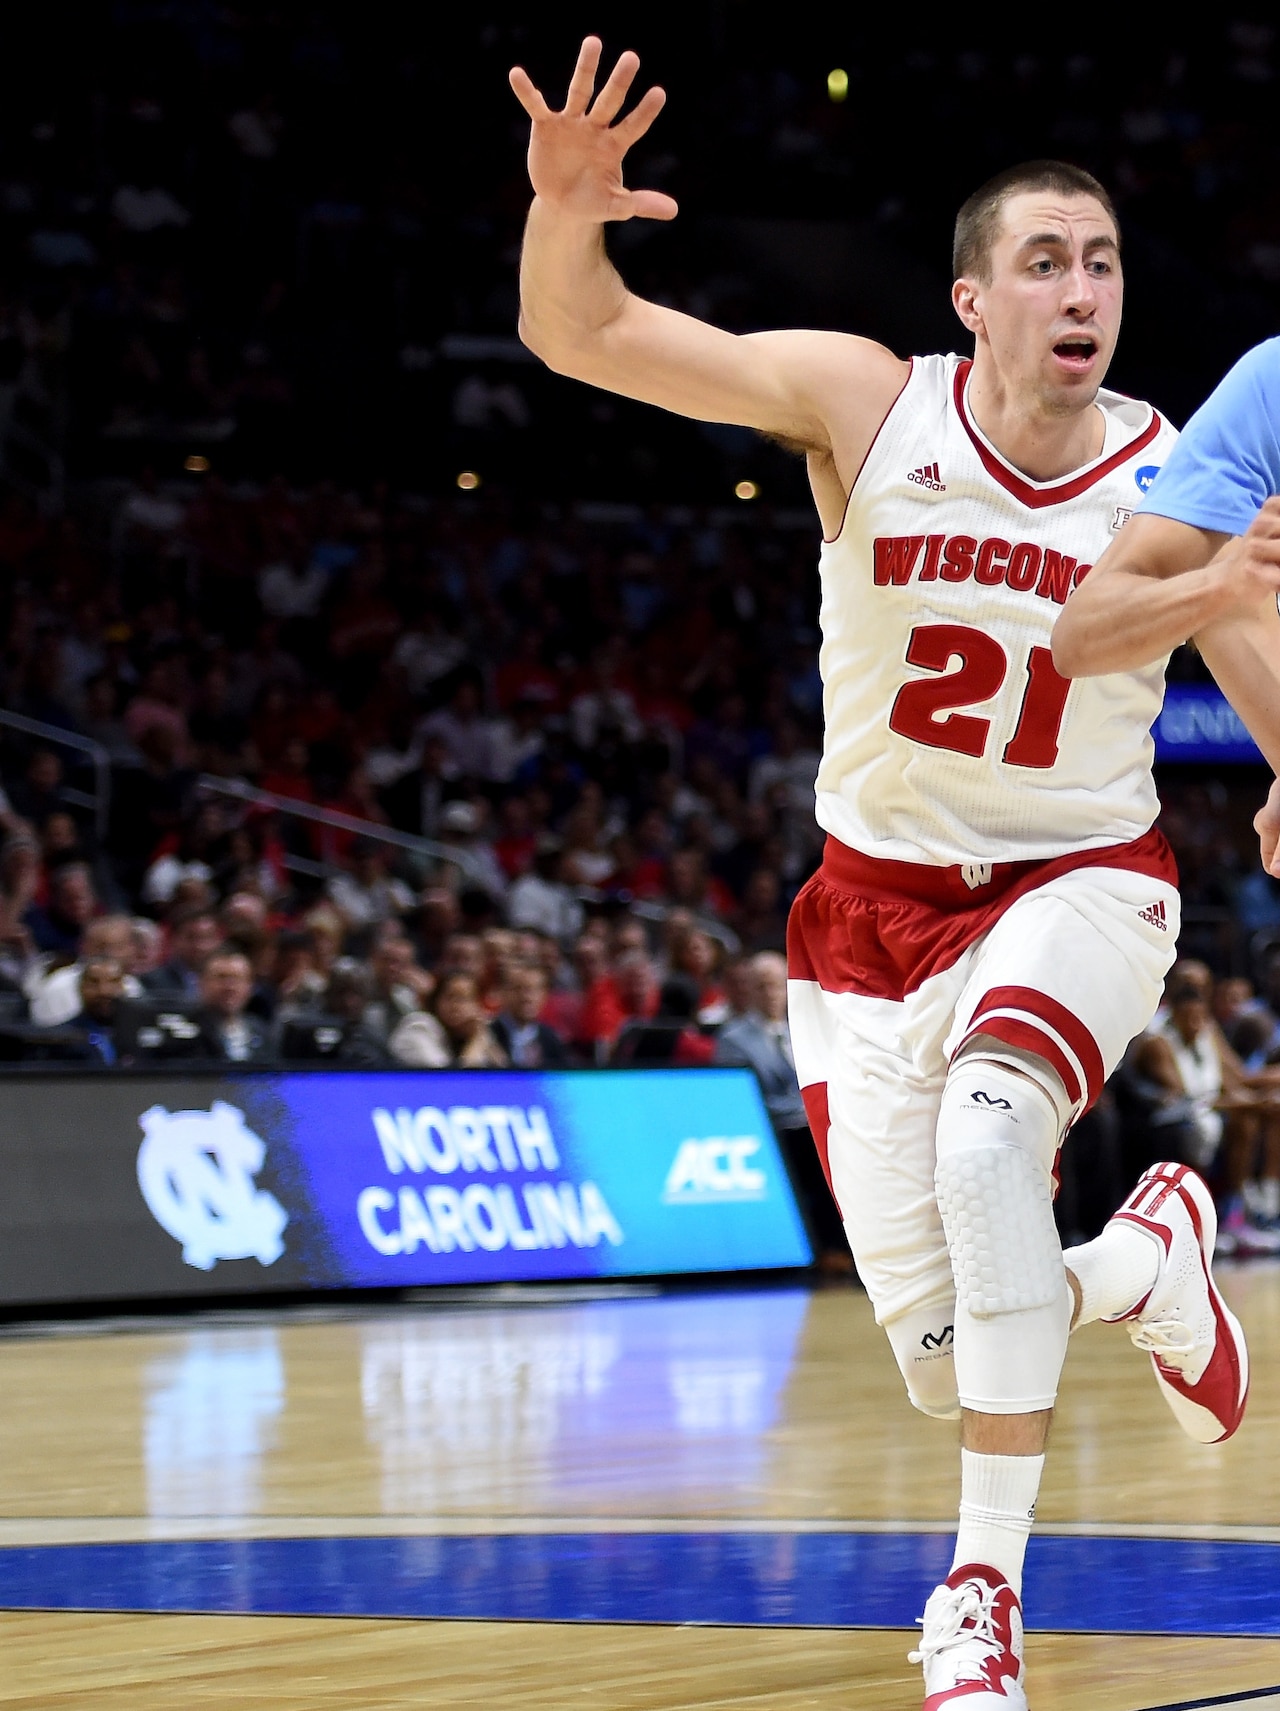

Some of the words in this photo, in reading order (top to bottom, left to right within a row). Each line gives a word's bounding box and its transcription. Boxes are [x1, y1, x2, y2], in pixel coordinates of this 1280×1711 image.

[907, 472, 947, 492] adidas
[889, 624, 1073, 769] 21
[373, 1105, 560, 1176] NORTH
[666, 1137, 768, 1192] ACC
[357, 1181, 624, 1257] CAROLINA
